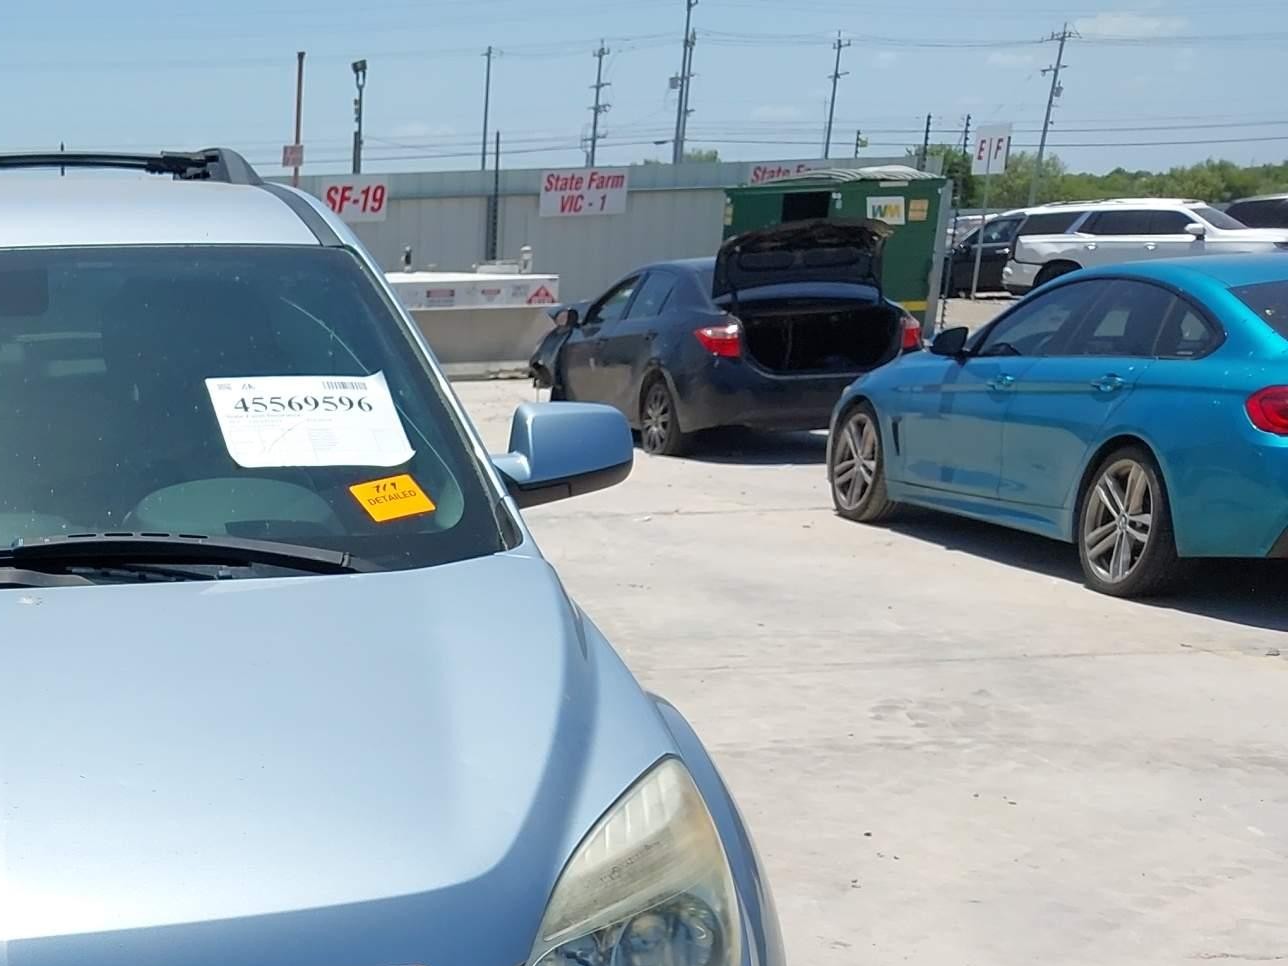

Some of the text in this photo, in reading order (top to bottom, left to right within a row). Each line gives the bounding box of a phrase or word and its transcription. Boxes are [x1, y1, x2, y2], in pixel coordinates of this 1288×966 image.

[544, 172, 625, 193] State Farm
[327, 185, 385, 214] SF-19
[560, 194, 585, 213] VIC
[599, 194, 607, 212] 1
[871, 203, 901, 218] WM
[234, 395, 373, 413] 45569596
[368, 490, 416, 505] DETAILED
